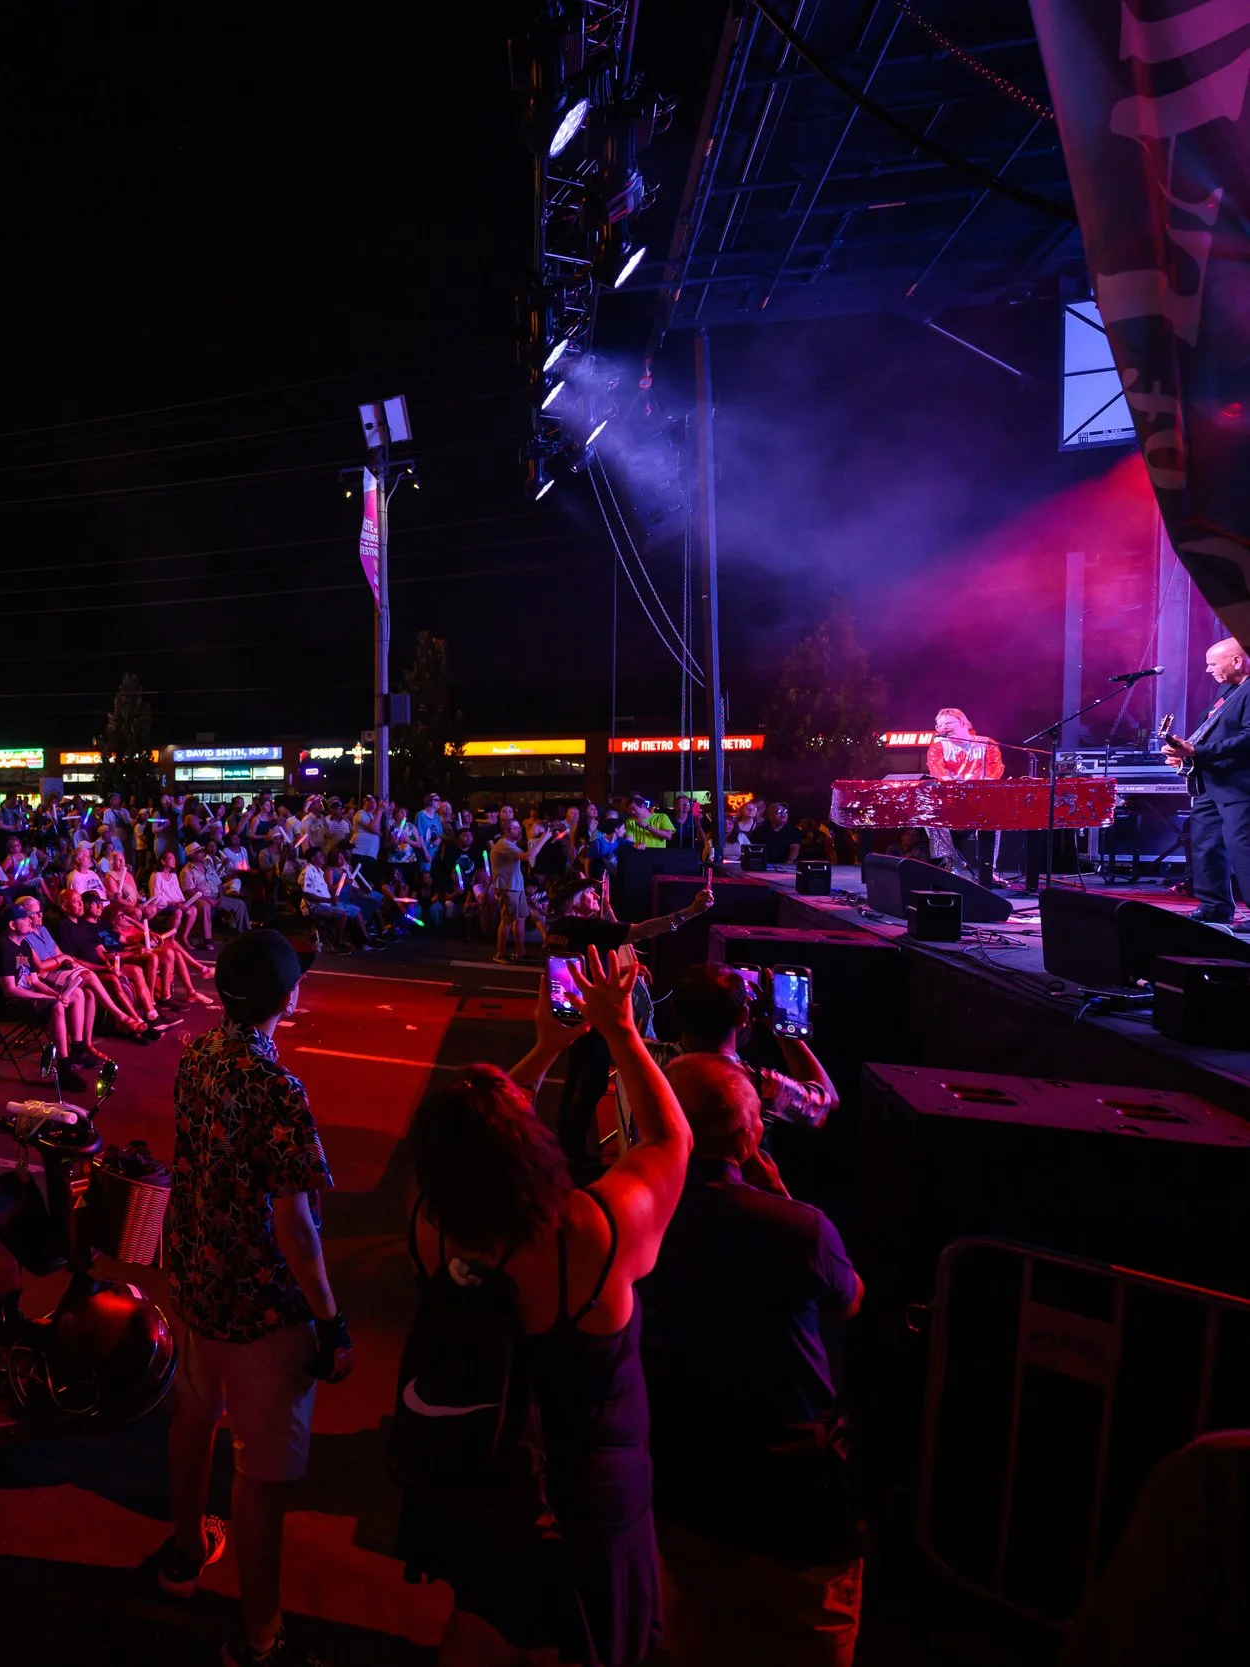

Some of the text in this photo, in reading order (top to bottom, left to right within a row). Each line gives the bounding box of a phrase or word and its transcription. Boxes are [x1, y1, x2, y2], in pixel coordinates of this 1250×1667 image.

[642, 740, 673, 750] METRO
[186, 747, 269, 758] DAVID SMITH, MPP
